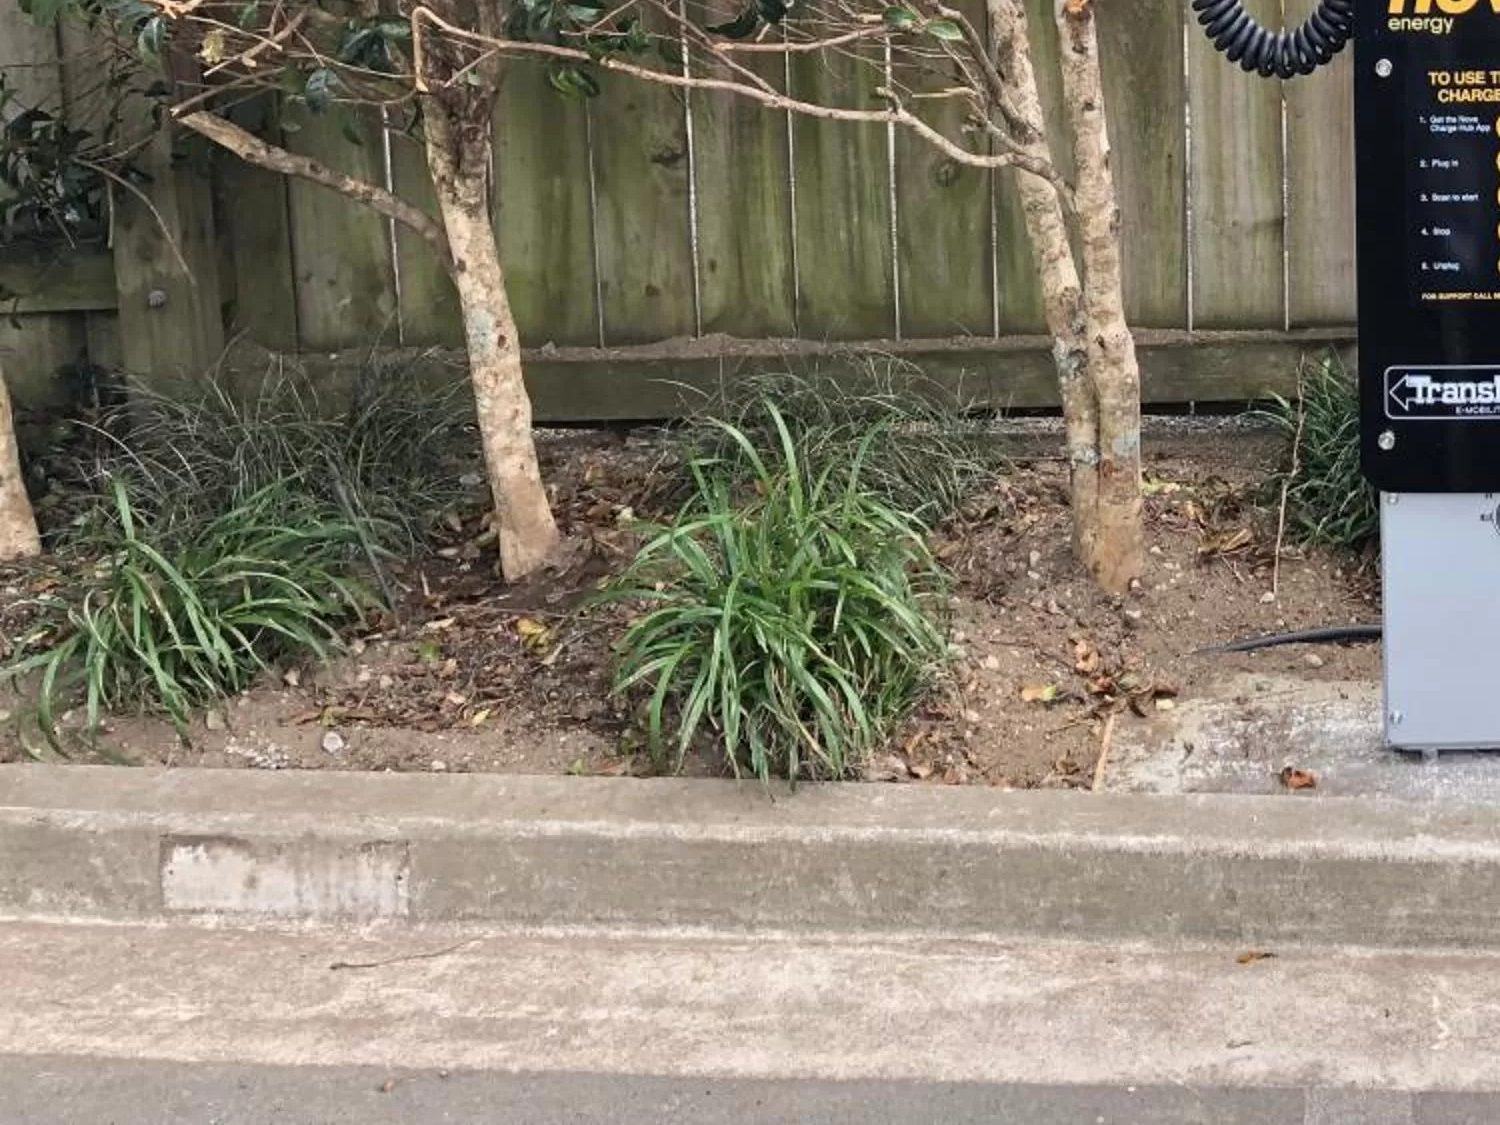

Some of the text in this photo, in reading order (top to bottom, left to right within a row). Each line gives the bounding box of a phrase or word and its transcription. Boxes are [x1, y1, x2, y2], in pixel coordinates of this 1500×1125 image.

[1388, 16, 1453, 34] energy
[1428, 72, 1450, 85] TO
[1454, 72, 1486, 84] USE
[1476, 124, 1491, 133] App
[1421, 292, 1437, 300] FOR
[1438, 292, 1473, 300] SUPPORT
[1473, 292, 1493, 300] CALL
